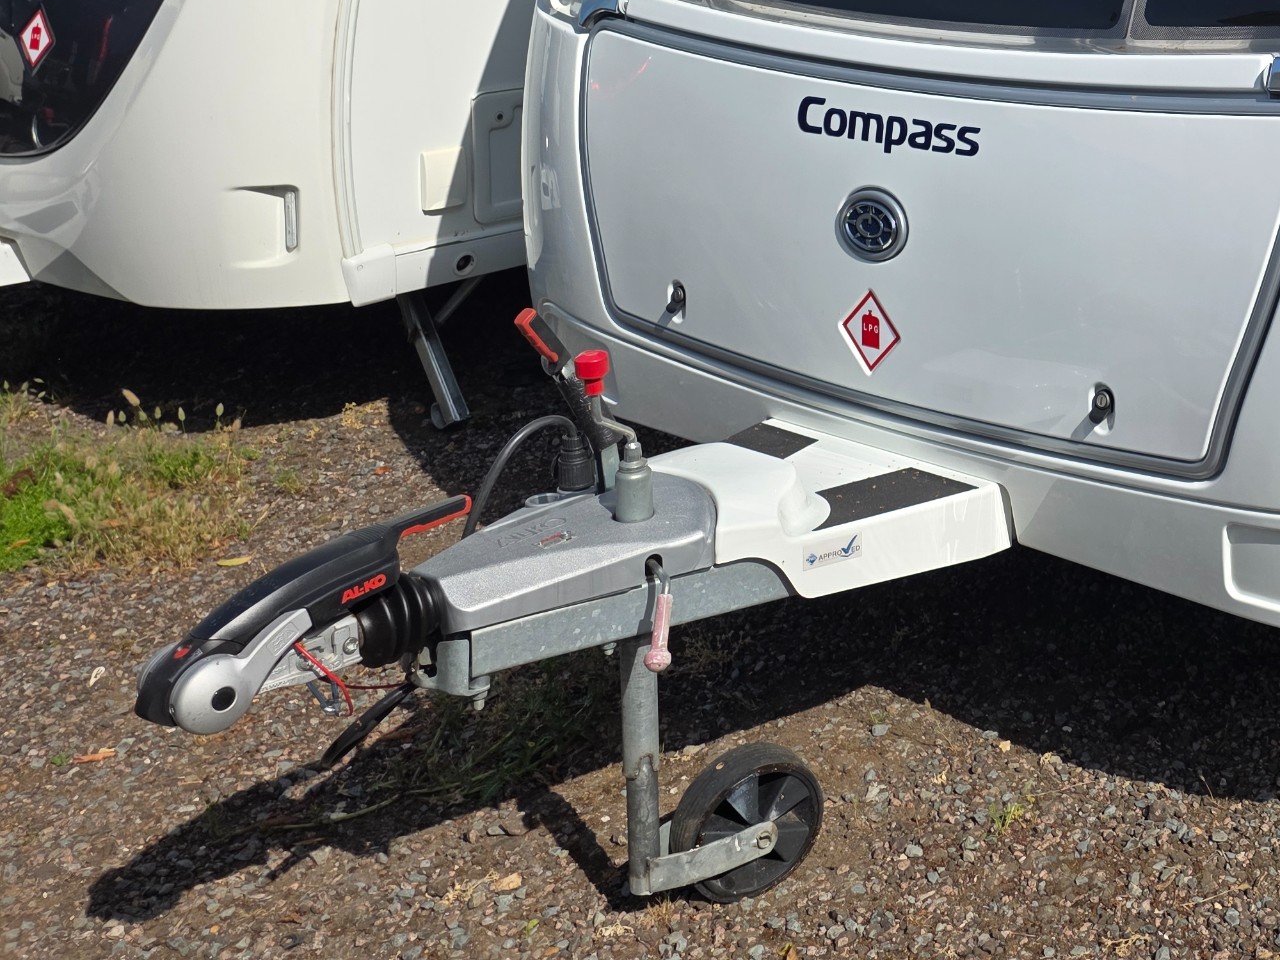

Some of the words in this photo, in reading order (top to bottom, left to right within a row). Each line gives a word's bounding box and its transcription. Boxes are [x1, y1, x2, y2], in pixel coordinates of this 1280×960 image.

[797, 95, 982, 157] Compass
[863, 322, 879, 335] LPG
[341, 573, 387, 605] AL-KO
